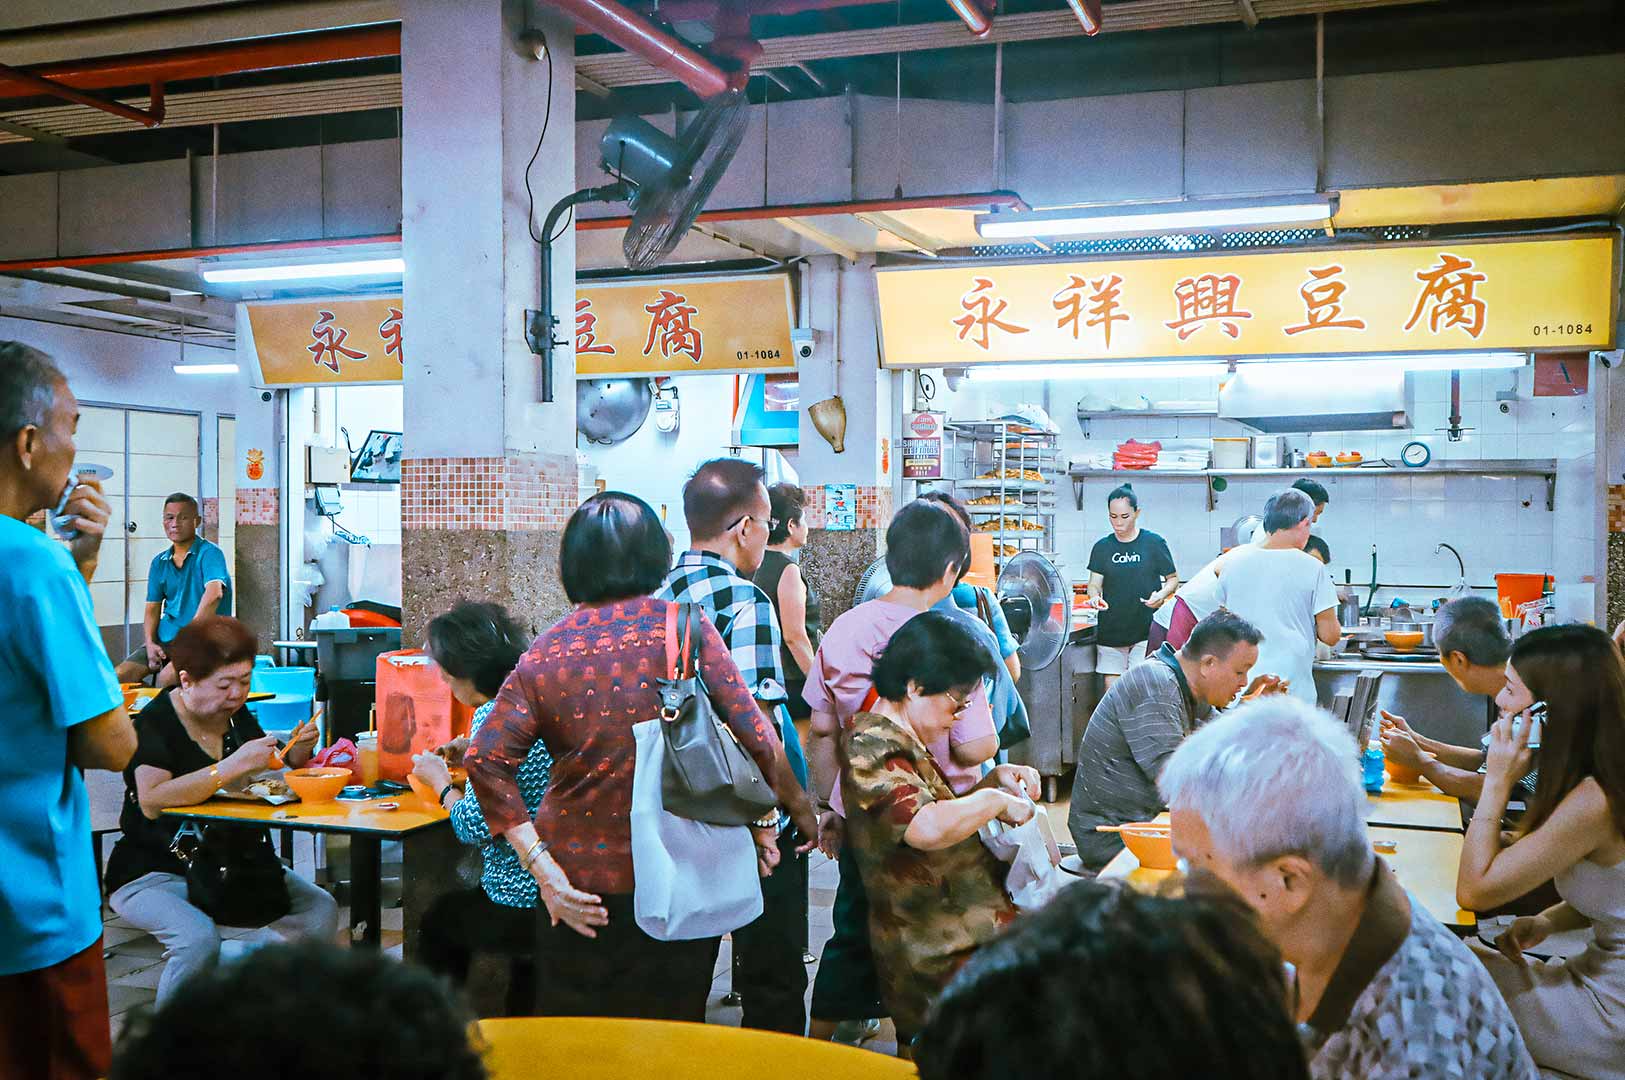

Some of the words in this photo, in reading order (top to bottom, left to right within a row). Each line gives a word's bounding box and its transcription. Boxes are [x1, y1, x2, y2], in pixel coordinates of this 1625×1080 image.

[952, 254, 1487, 350] 永祥興豆腐
[1533, 322, 1593, 336] 01-1084
[736, 350, 781, 361] 01-1084
[1112, 552, 1140, 563] Calvin
